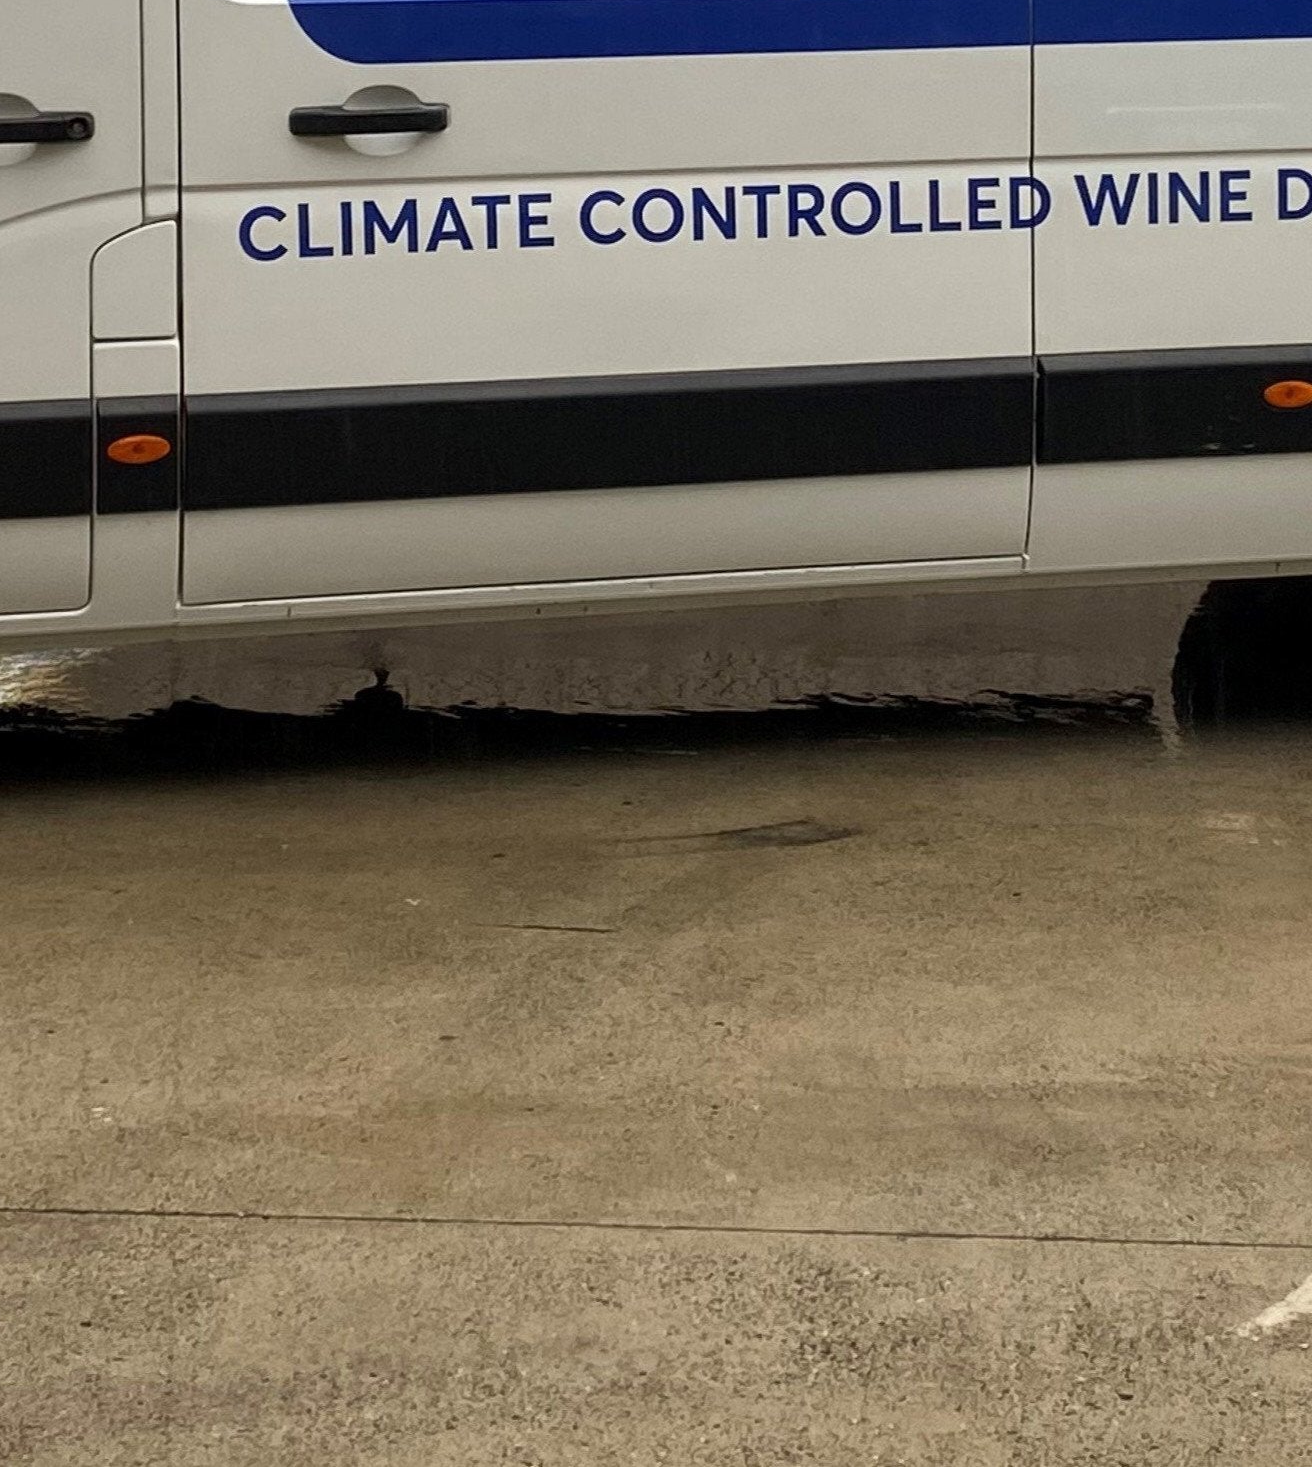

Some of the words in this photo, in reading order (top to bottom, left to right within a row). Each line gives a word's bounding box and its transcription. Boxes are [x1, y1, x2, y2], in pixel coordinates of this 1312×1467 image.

[237, 191, 557, 263] CLIMATE
[578, 176, 1052, 246] CONTROLLED
[1073, 167, 1255, 228] WINE
